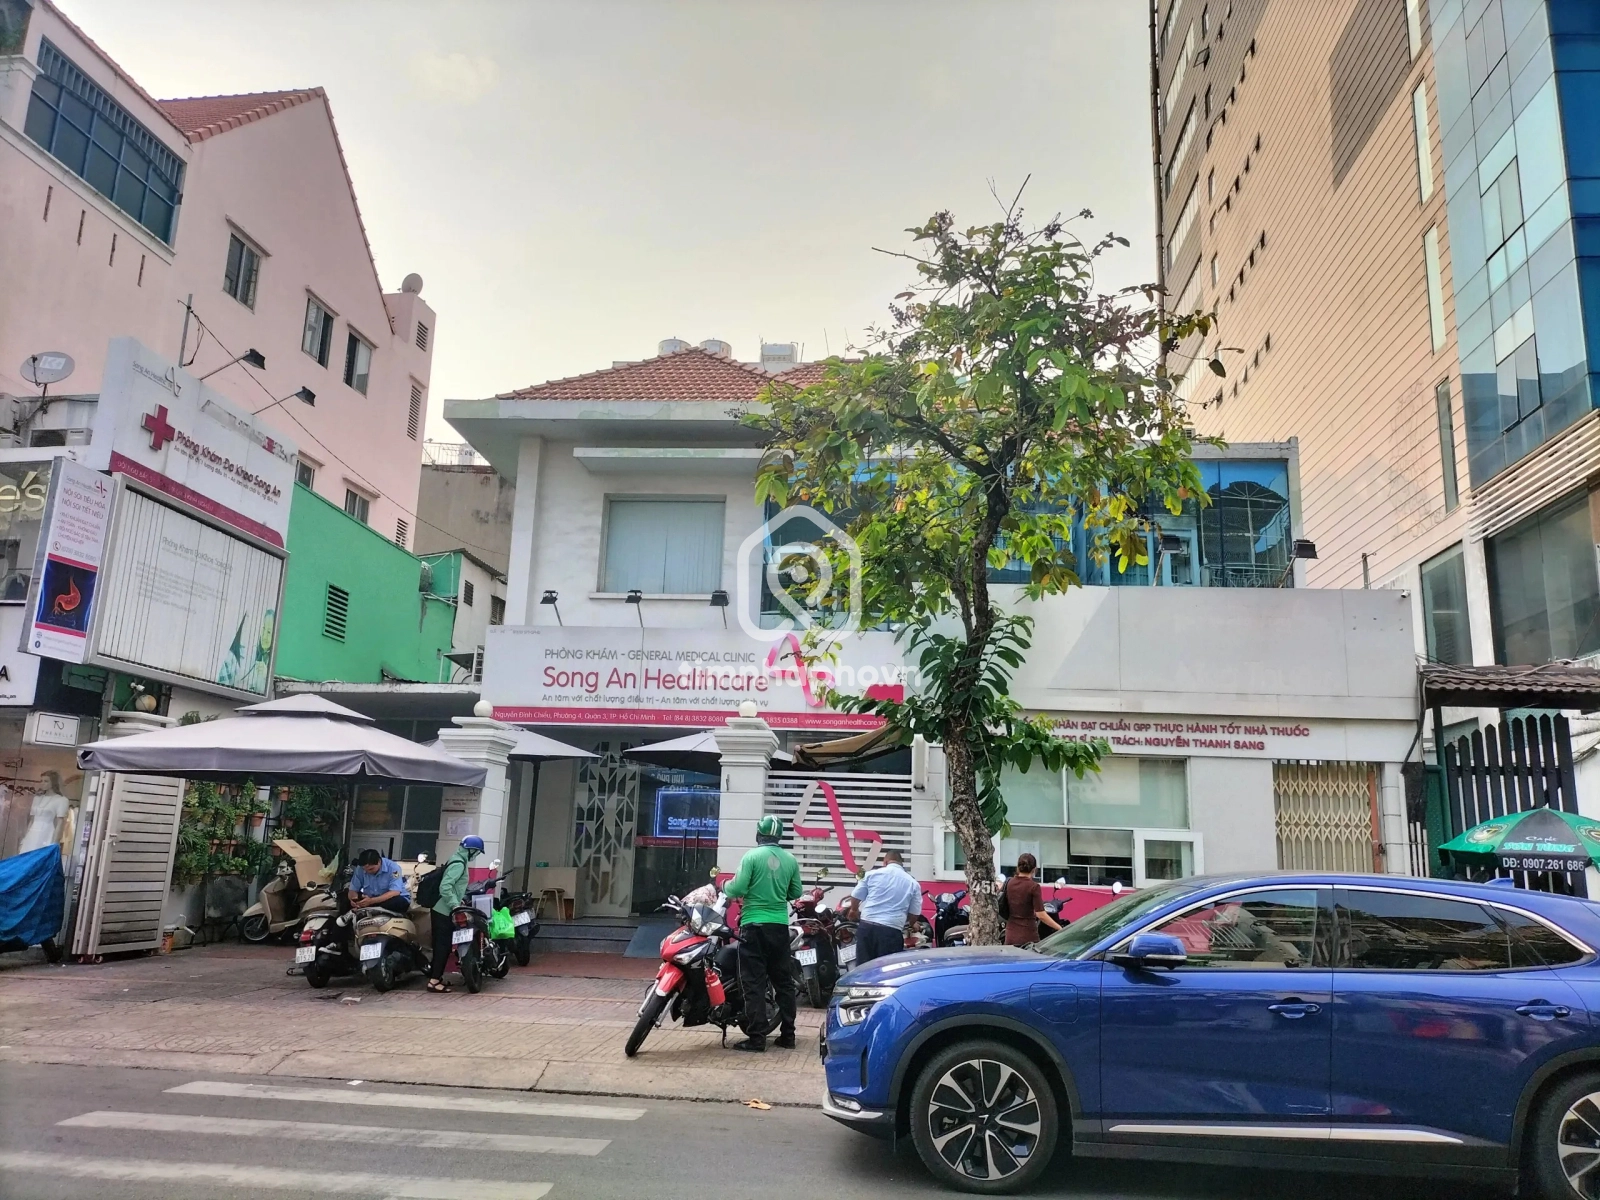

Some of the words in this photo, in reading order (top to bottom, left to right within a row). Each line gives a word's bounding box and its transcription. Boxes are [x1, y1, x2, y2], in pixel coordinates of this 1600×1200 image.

[201, 445, 222, 466] Khám
[222, 458, 234, 472] Đa
[235, 464, 253, 482] Khoa
[254, 475, 271, 494] Song
[272, 485, 281, 498] An
[544, 647, 583, 659] PHÒNG
[586, 648, 618, 660] KHÁM
[627, 650, 672, 661] GENERAL
[675, 651, 720, 662] MEDICAL
[723, 652, 755, 663] CLINIC
[543, 666, 599, 693] Song
[606, 667, 636, 689] An
[644, 668, 769, 692] Healthcare
[554, 694, 570, 702] tâm
[571, 694, 583, 702] với
[585, 694, 602, 703] chất
[603, 695, 625, 705] lượng
[646, 696, 654, 704] trị
[660, 696, 671, 704] An
[688, 696, 700, 704] với
[701, 696, 718, 705] chất
[719, 697, 740, 707] lượng
[495, 711, 518, 719] Nguyễn
[554, 712, 576, 720] Phường
[640, 713, 656, 721] Minh
[674, 714, 683, 722] (84
[1080, 721, 1097, 732] ĐẠT
[1100, 718, 1130, 731] CHUẨN
[1133, 723, 1150, 732] GPP
[1153, 723, 1183, 734] THỰC
[1186, 722, 1217, 734] HÀNH
[1220, 722, 1241, 735] TỐT
[1244, 724, 1268, 736] NHÀ
[1270, 724, 1309, 736] THUỐC
[1111, 734, 1143, 745] TRÁCH:
[1145, 736, 1190, 747] NGUYỄN
[1192, 739, 1230, 748] THANH
[1234, 740, 1265, 750] SANG
[668, 816, 688, 827] Song
[689, 817, 700, 826] An
[1502, 857, 1520, 868] DĐ:
[1523, 858, 1564, 870] 0907.261
[1567, 860, 1584, 871] 686
